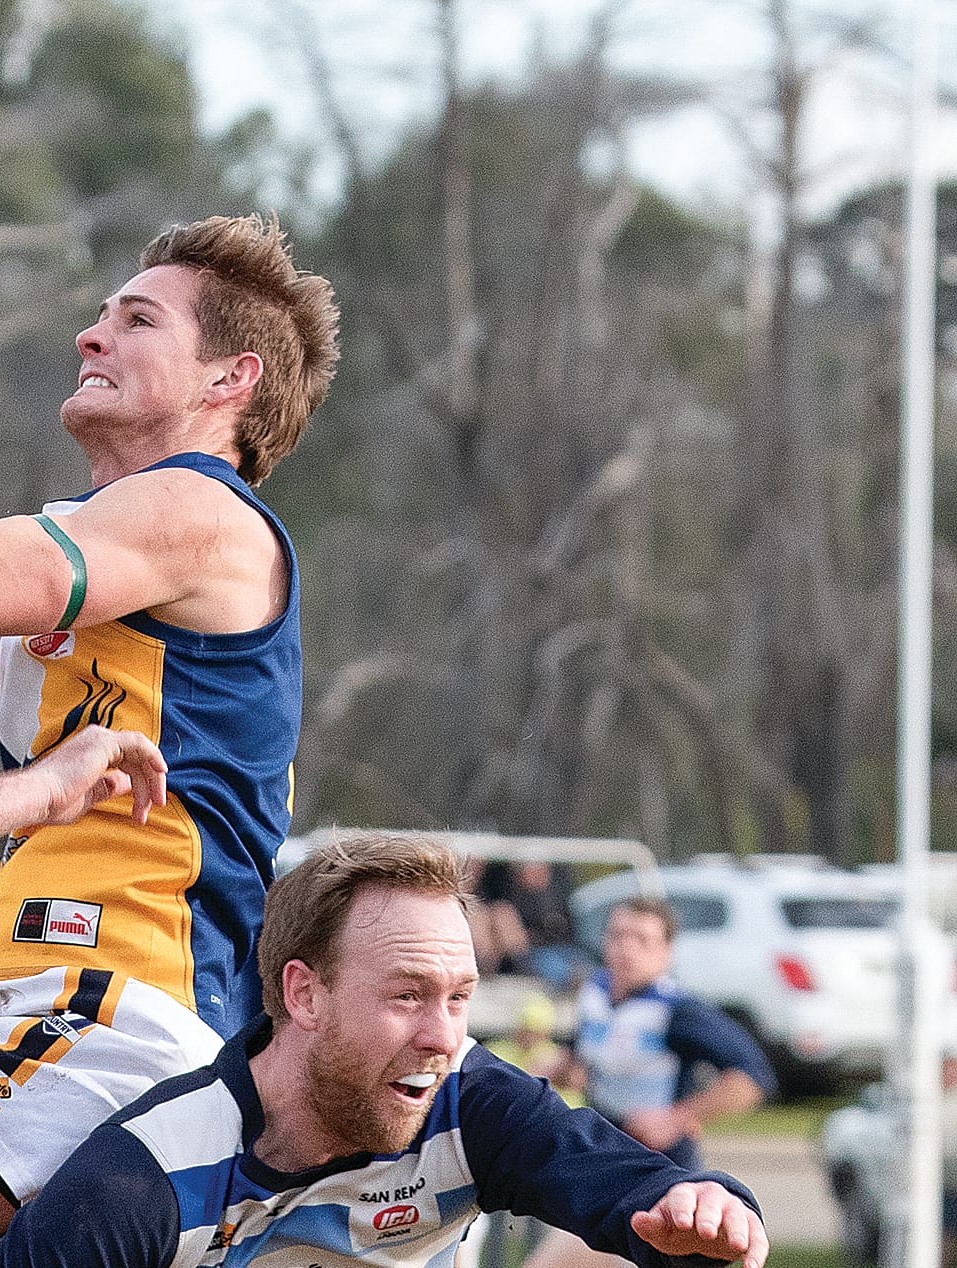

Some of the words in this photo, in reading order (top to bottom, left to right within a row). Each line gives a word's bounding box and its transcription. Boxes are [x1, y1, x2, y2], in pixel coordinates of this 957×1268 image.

[49, 920, 86, 936] PUMA
[358, 1190, 390, 1203] SAN
[394, 1177, 426, 1201] REMO
[378, 1206, 416, 1229] IGA
